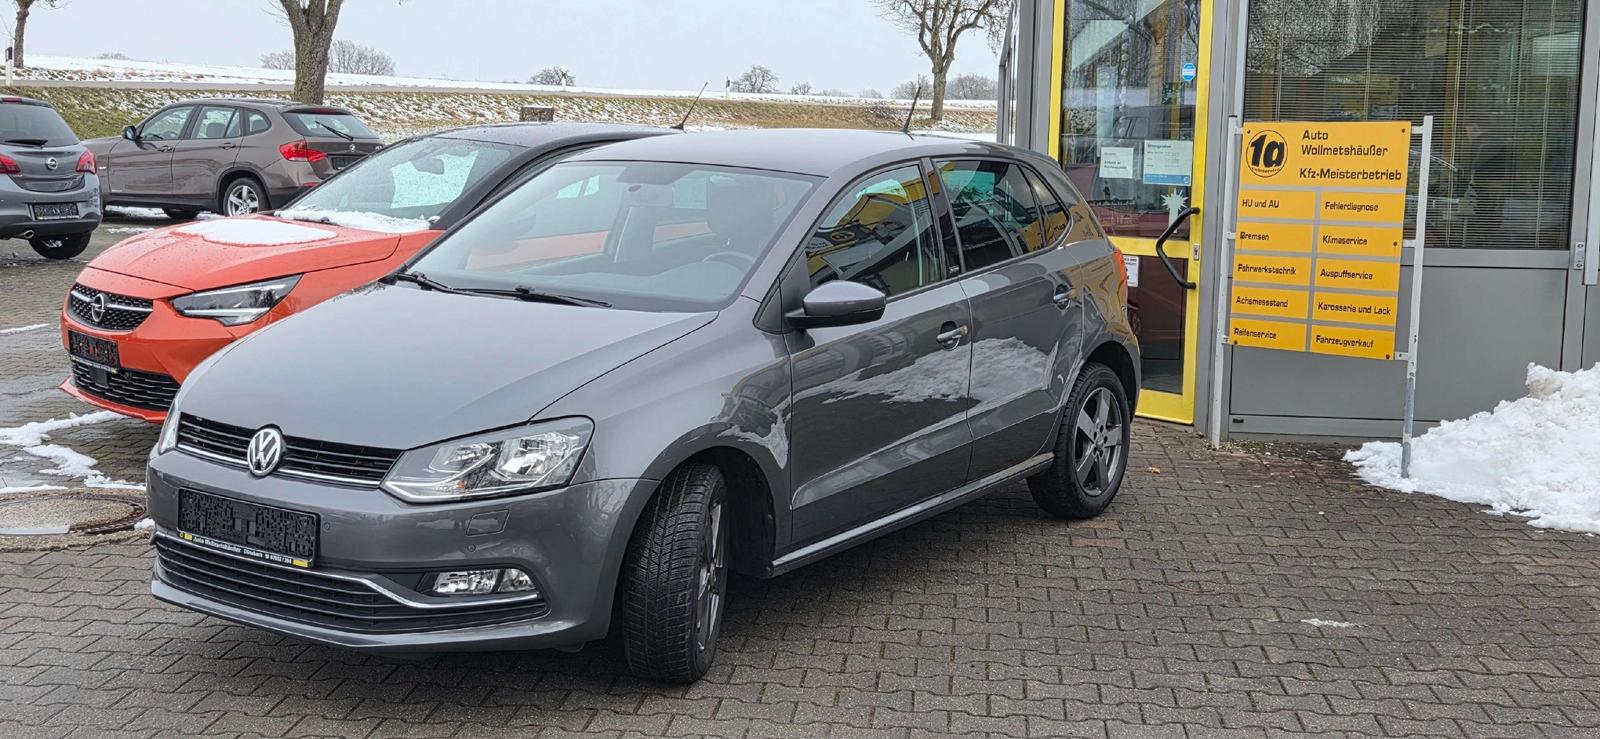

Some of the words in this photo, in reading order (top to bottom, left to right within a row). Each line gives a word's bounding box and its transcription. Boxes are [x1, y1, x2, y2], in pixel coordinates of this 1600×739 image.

[1302, 129, 1329, 141] Auto
[1250, 134, 1285, 168] 1a
[1301, 144, 1388, 156] Wollmetshäußer
[1299, 167, 1402, 181] Kfz-Meisterbetrieb
[1242, 199, 1253, 208] HU
[1254, 199, 1267, 208] und
[1268, 199, 1280, 209] AU
[1324, 201, 1379, 213] Fehlerdiagnose
[1240, 231, 1270, 241] Bremsen
[1322, 235, 1368, 246] Klimaservice
[1237, 263, 1297, 275] Fahrwerkstechnik
[1320, 268, 1374, 280] Auspuffservice
[1235, 295, 1289, 308] Achsmessstand
[1317, 302, 1357, 313] Karosserie
[1358, 305, 1372, 314] und
[1373, 305, 1391, 316] Lack
[1233, 327, 1277, 340] Reifenservice
[1315, 334, 1374, 348] Fahrzeugverkauf
